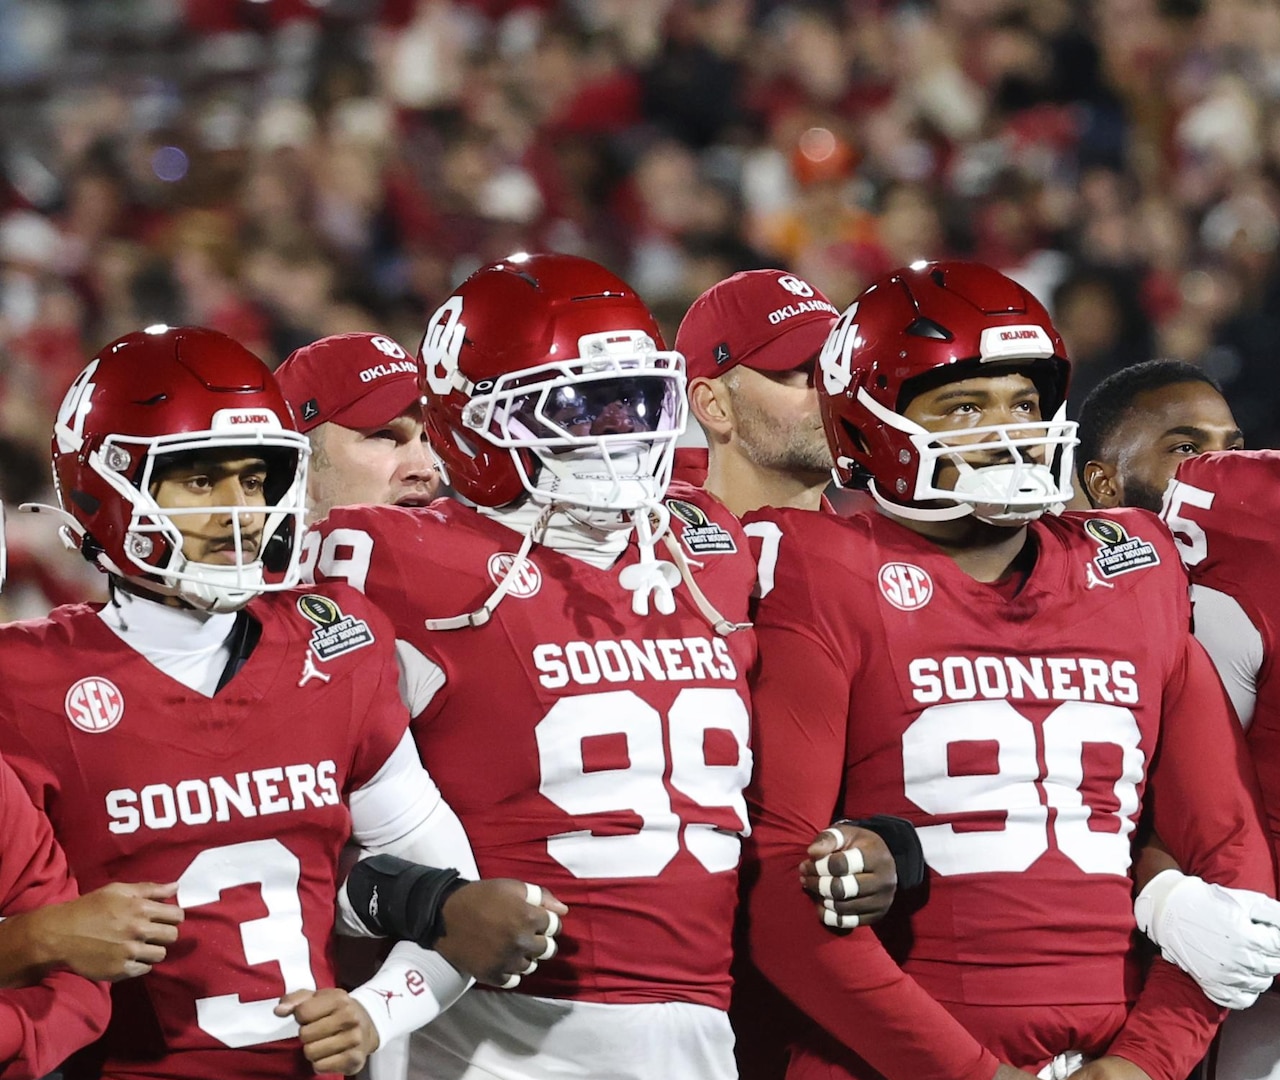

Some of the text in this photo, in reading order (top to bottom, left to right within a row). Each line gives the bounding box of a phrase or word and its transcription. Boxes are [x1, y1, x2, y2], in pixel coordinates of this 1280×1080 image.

[359, 361, 418, 382] OKLAHO
[1102, 540, 1138, 557] PLAYOFF
[1158, 478, 1216, 572] 5
[1098, 553, 1124, 567] FIRST
[1124, 545, 1152, 560] ROUND
[880, 563, 930, 608] SEC
[532, 636, 738, 689] SOONERS
[908, 656, 1139, 704] SOONERS
[69, 680, 121, 730] SEC
[105, 760, 340, 834] SOONERS
[533, 688, 754, 879] 99
[902, 699, 1145, 877] 90
[176, 838, 317, 1049] 3
